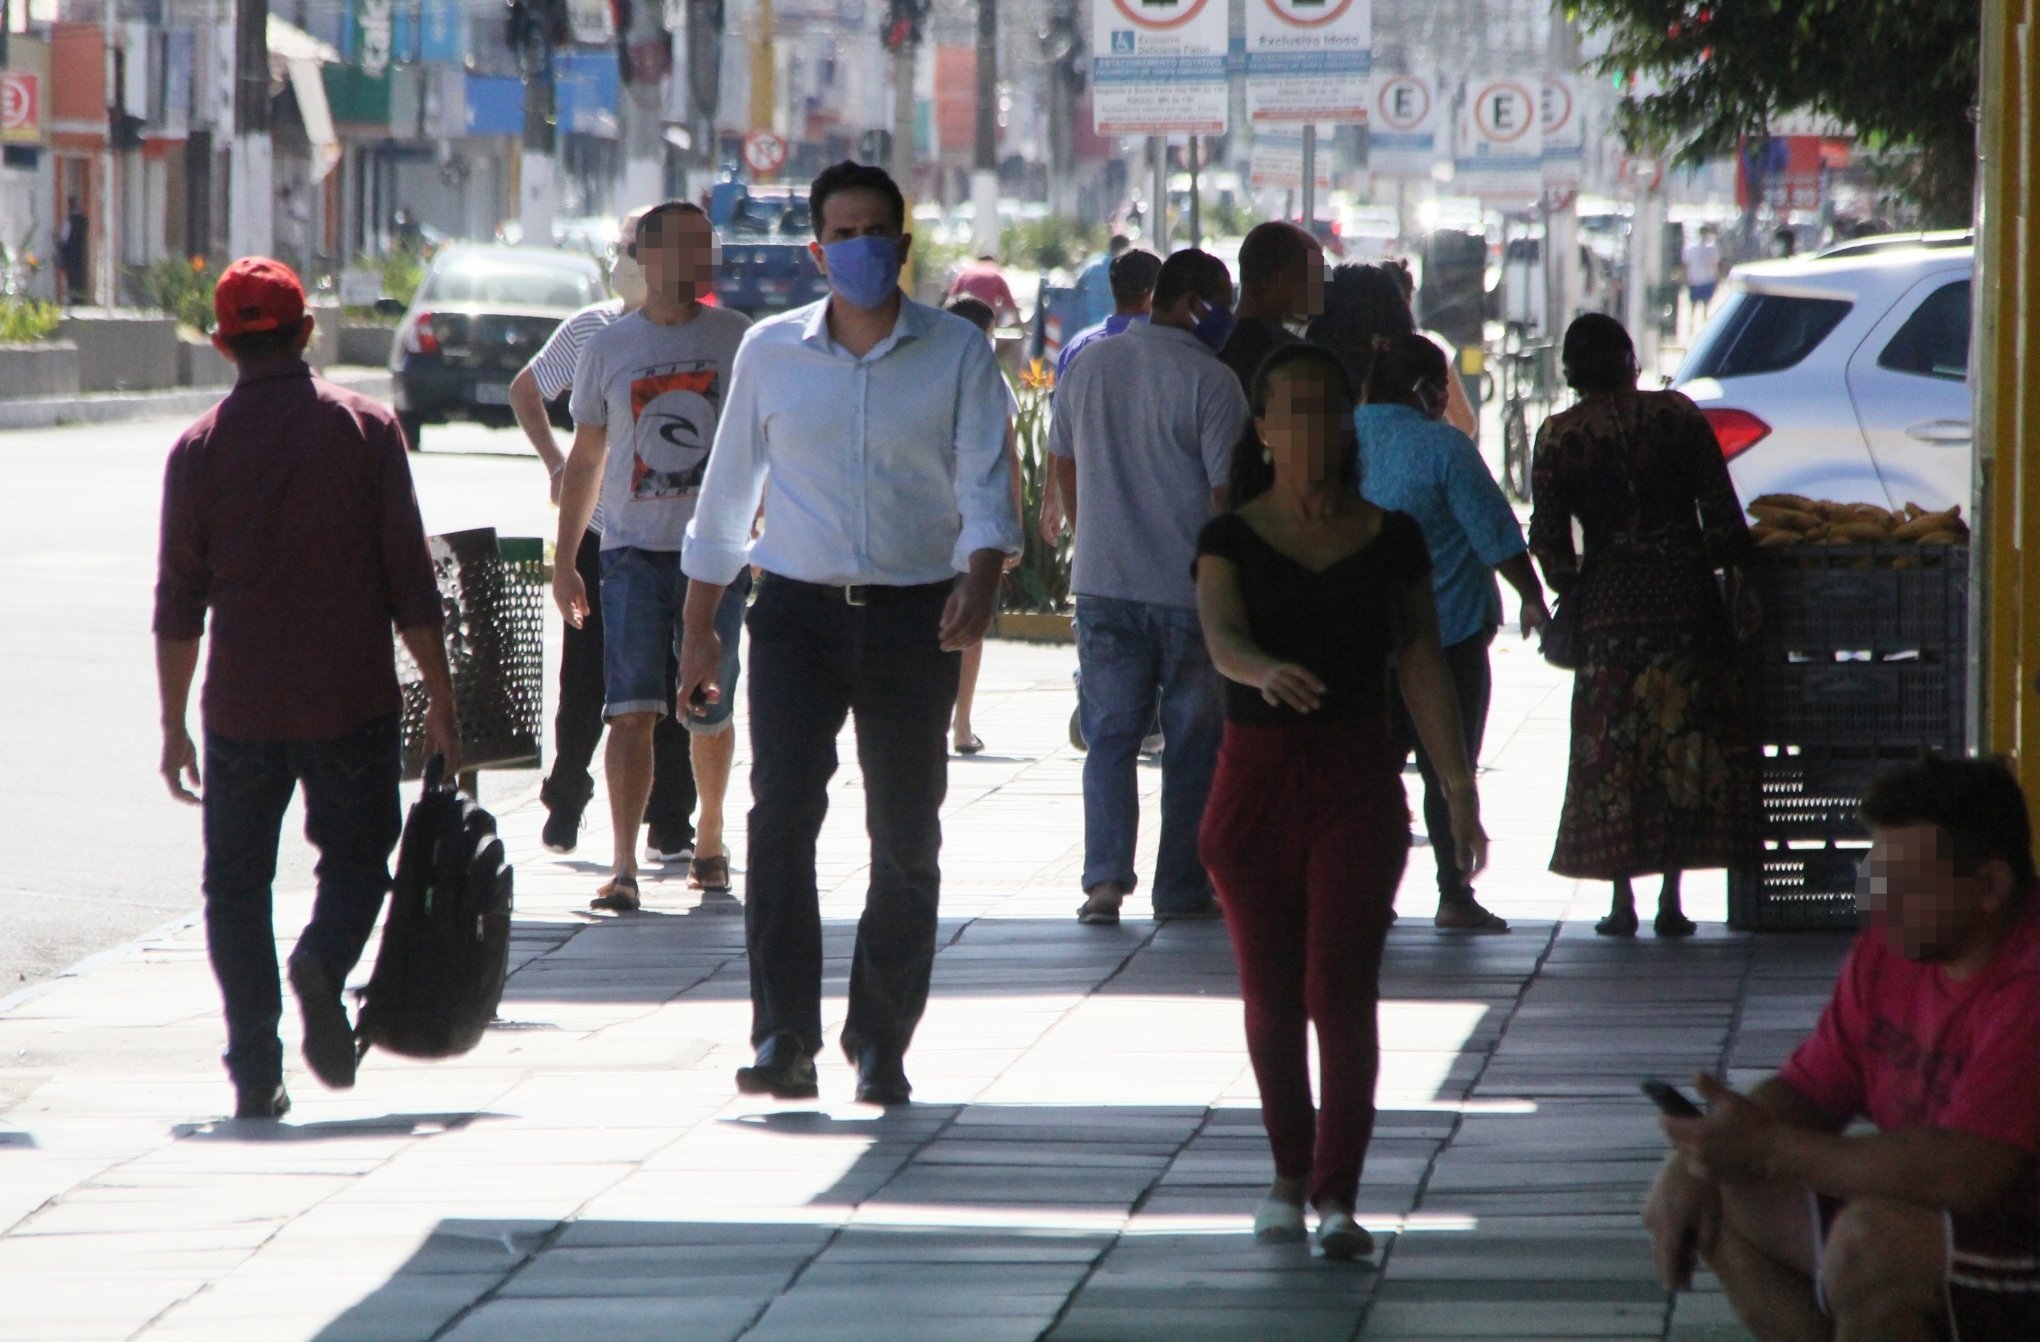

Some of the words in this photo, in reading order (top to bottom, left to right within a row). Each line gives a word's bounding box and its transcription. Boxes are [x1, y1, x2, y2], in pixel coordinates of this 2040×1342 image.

[1259, 35, 1321, 47] Exclusivo
[1324, 35, 1359, 46] Idoso
[1395, 88, 1413, 118] E
[1493, 94, 1513, 129] E
